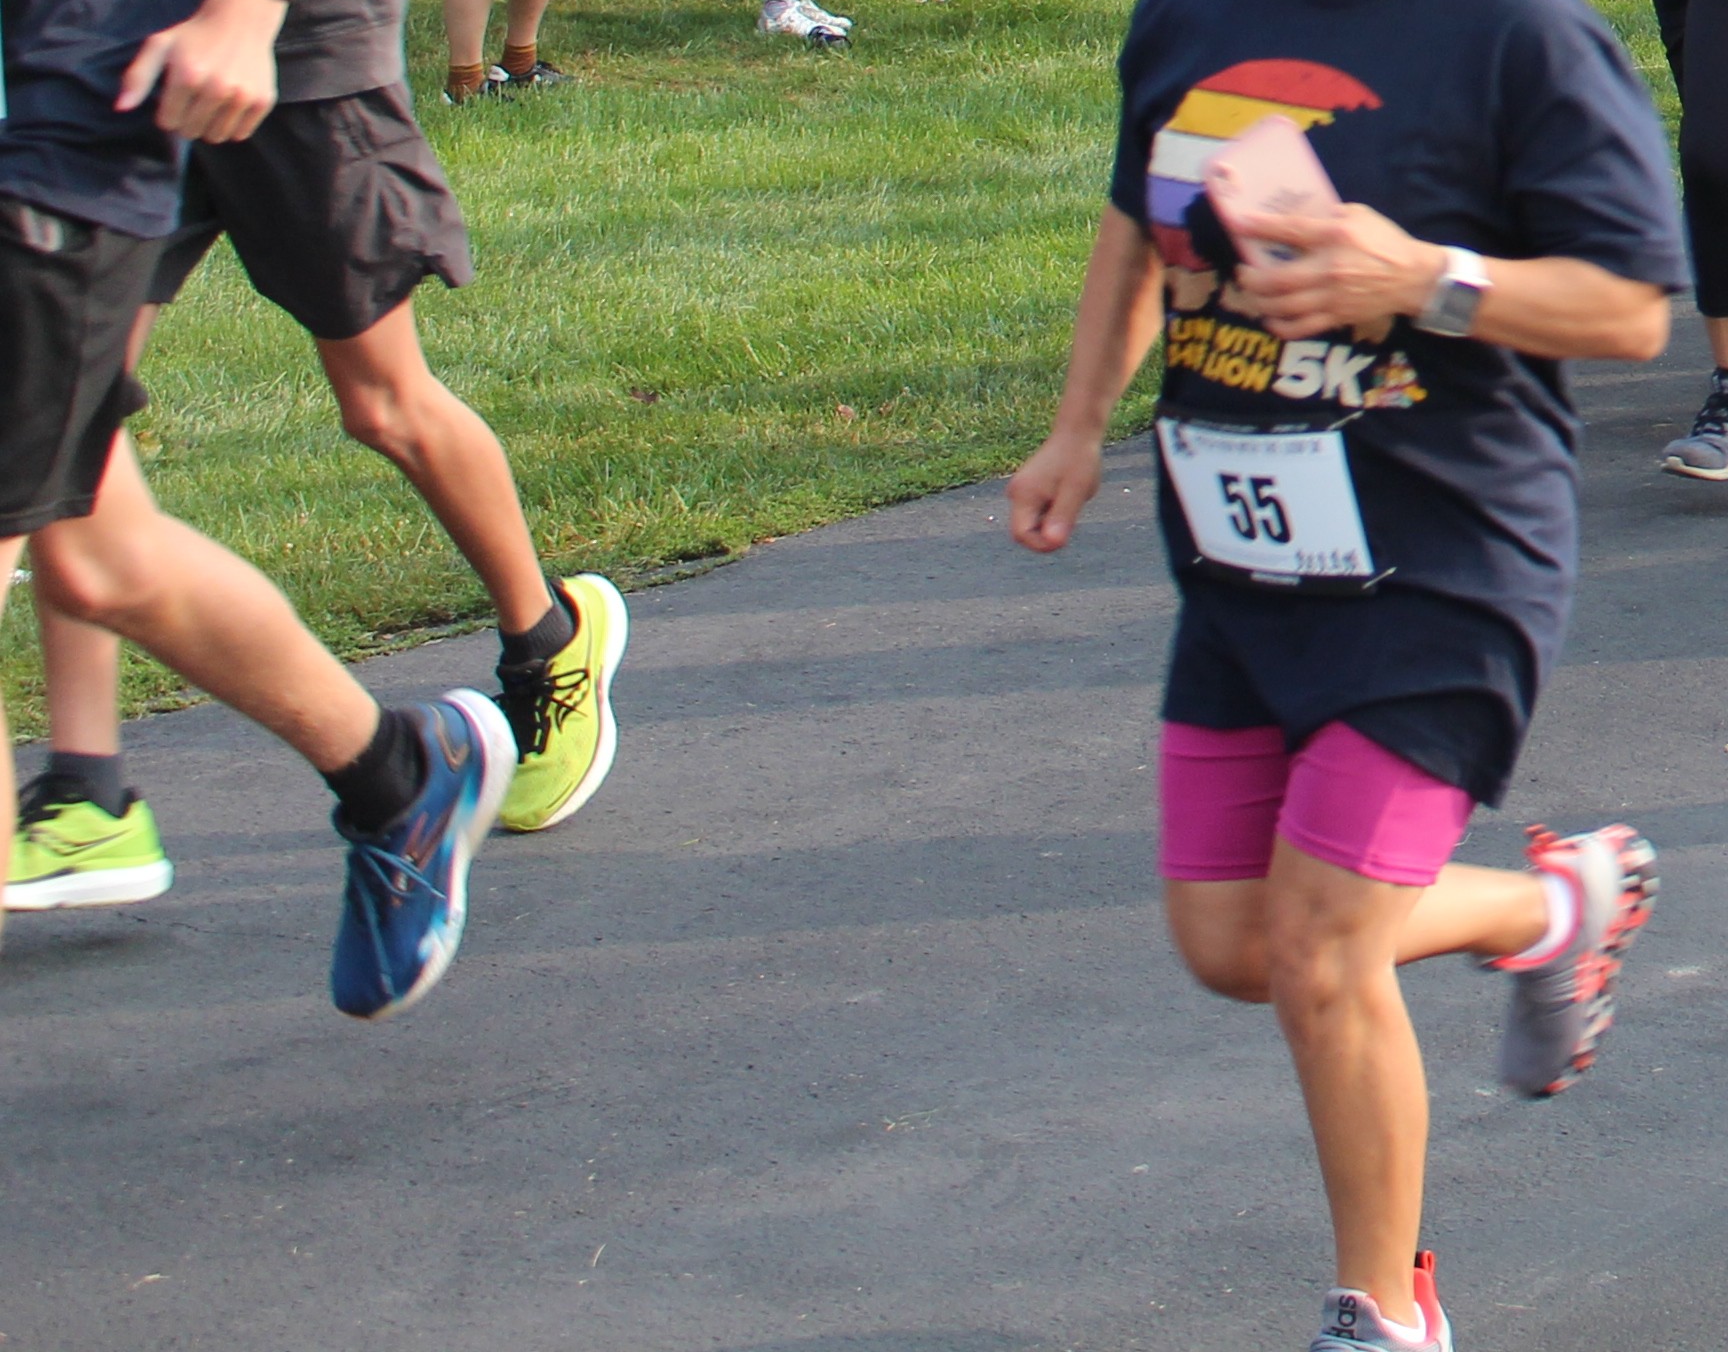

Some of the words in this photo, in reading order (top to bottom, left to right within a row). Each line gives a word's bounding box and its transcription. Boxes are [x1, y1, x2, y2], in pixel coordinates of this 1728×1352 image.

[1202, 350, 1275, 392] LION
[1214, 324, 1280, 362] WITH
[1271, 339, 1377, 409] 5K
[1217, 472, 1292, 544] 55
